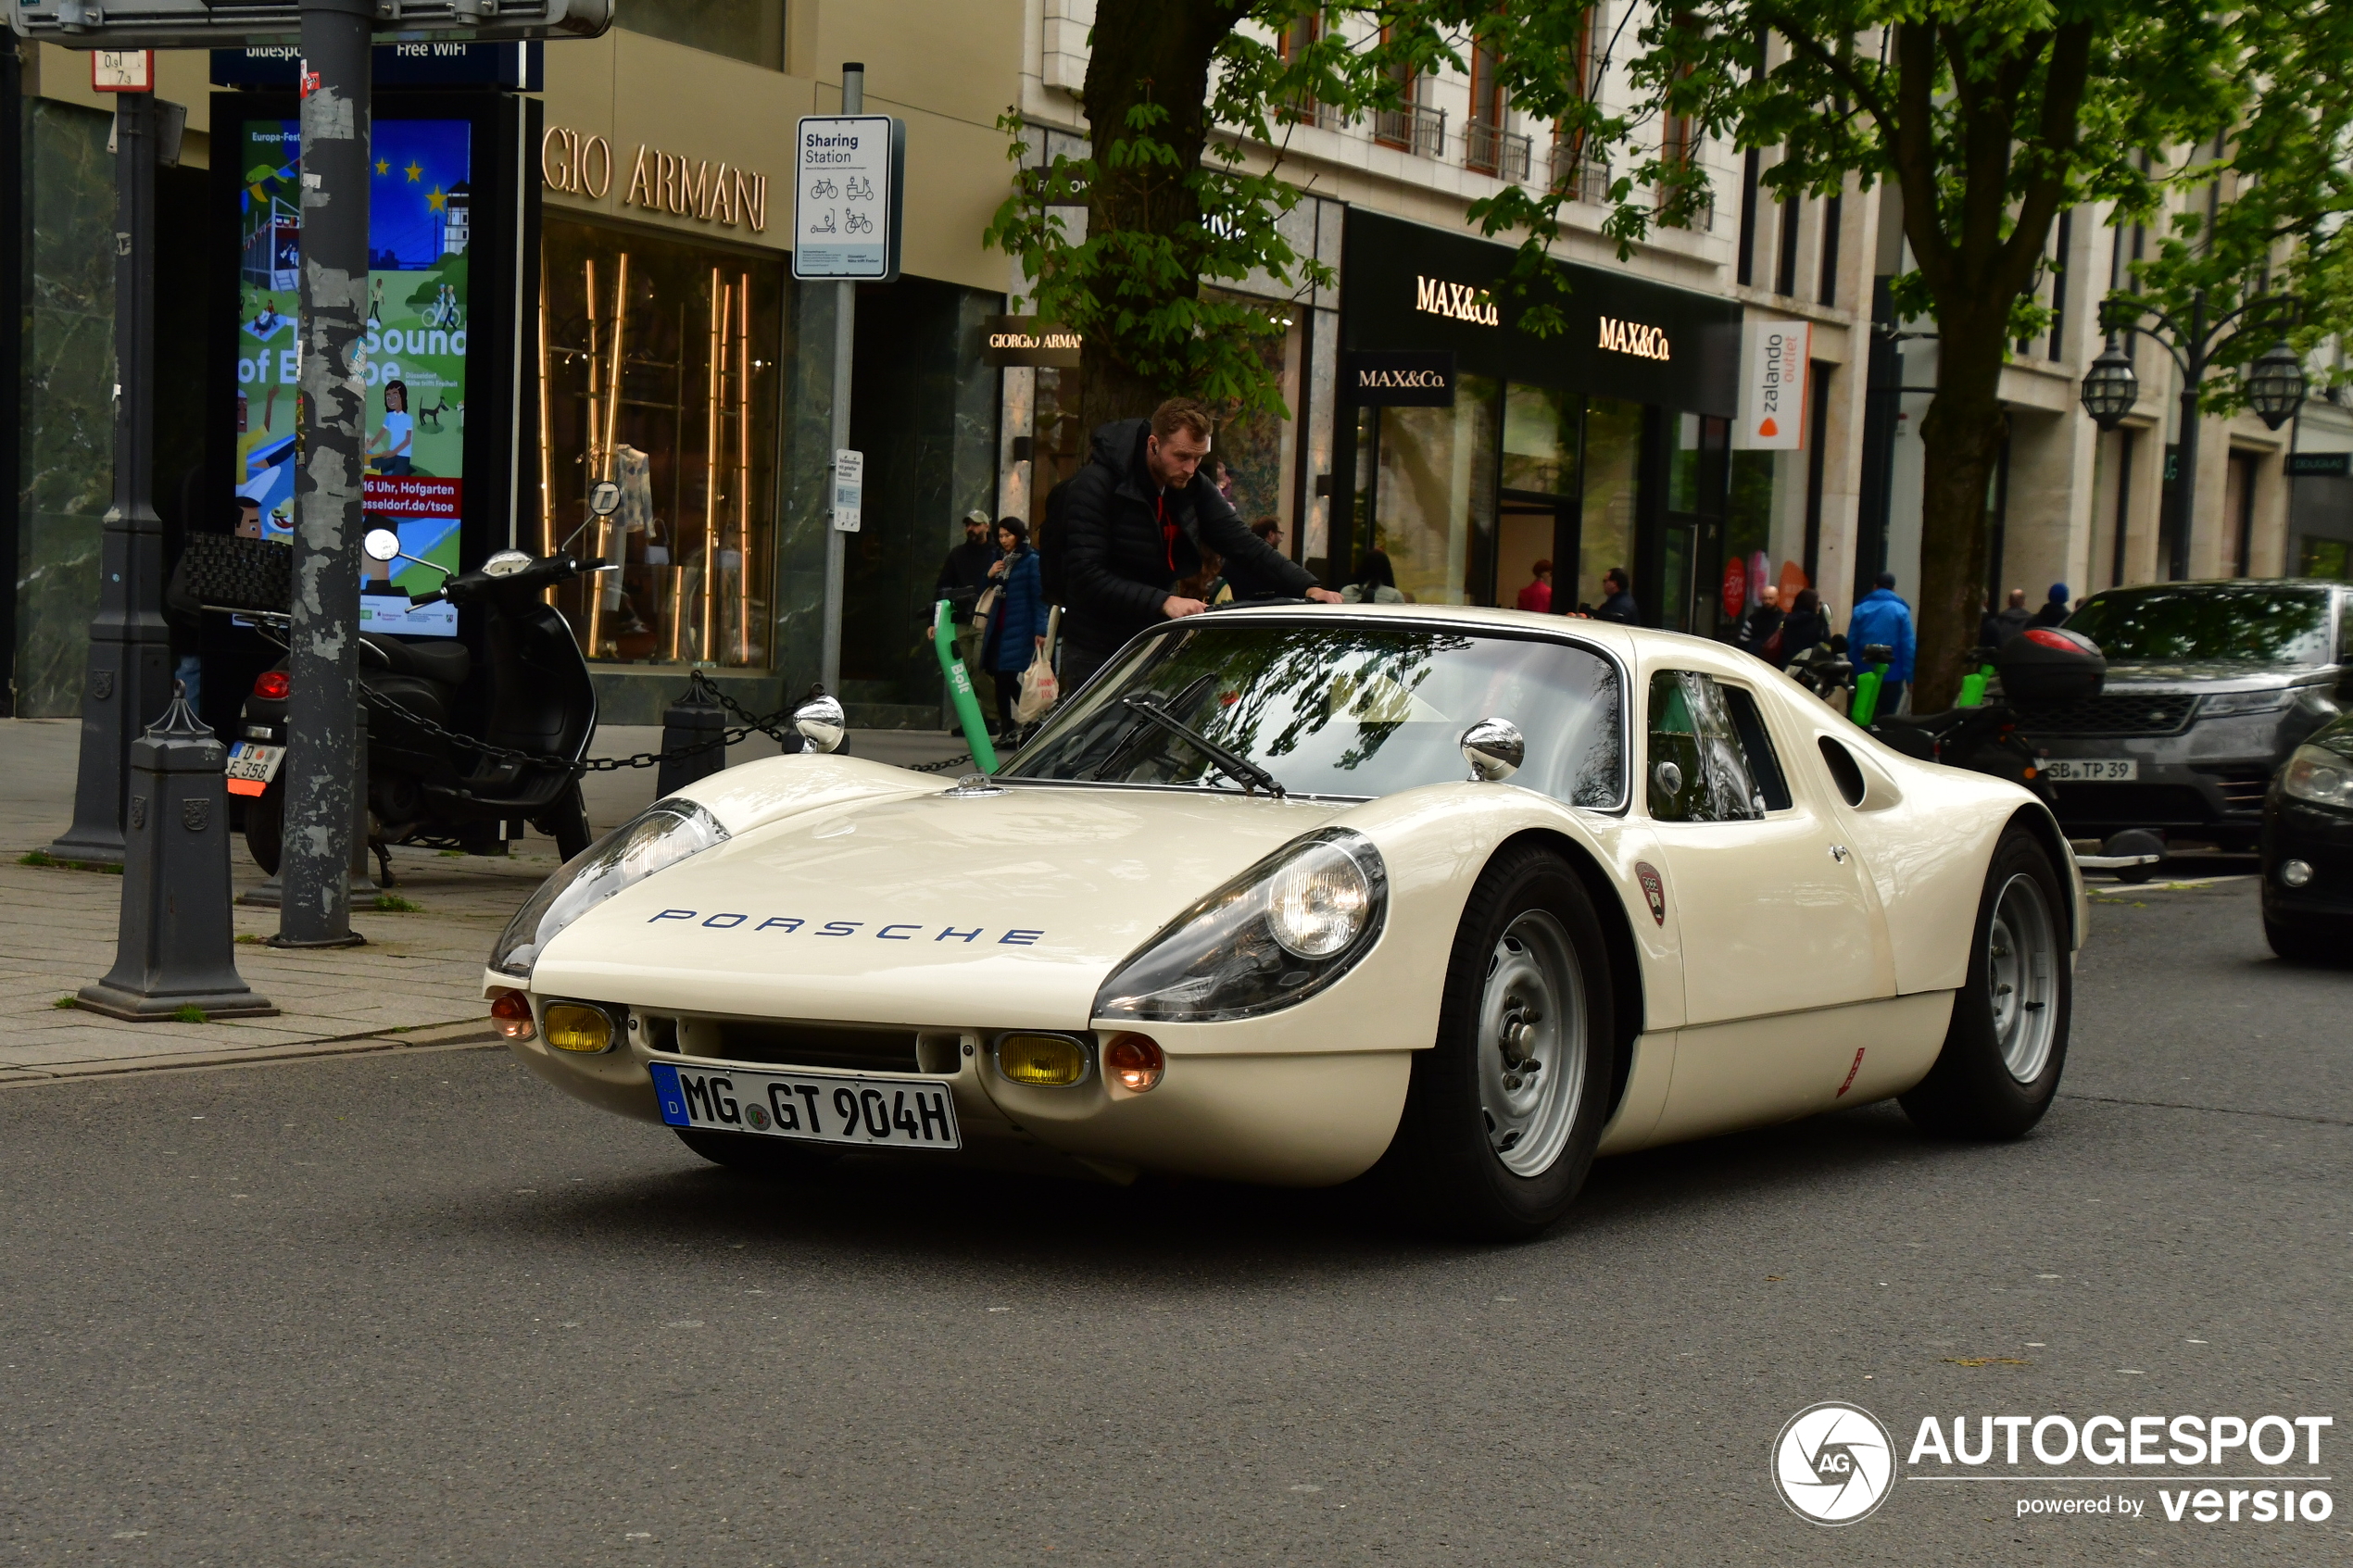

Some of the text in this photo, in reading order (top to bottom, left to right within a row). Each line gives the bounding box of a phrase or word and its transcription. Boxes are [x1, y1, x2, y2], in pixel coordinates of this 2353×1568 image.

[396, 43, 429, 56] Free
[806, 133, 859, 150] Sharing
[805, 149, 851, 163] Station
[625, 144, 767, 232] ARMANI
[1416, 275, 1499, 327] MAX&Co.
[989, 333, 1040, 348] GIORGIO
[1598, 316, 1670, 361] MAX&Co.
[238, 348, 271, 383] of
[1784, 335, 1798, 383] outlet
[1358, 370, 1445, 387] MAX&Co.
[1762, 334, 1782, 413] zalando
[376, 481, 398, 495] Uhr,
[400, 482, 455, 496] Hofgarten
[362, 497, 454, 512] esseldorf.de/tsoe
[950, 662, 970, 695] Bolt
[244, 745, 255, 759] D
[229, 760, 269, 779] E 358
[2082, 762, 2105, 778] TP
[2108, 762, 2129, 778] 39
[647, 909, 1046, 946] PORSCHE
[668, 1073, 951, 1142] D MG GT 904H
